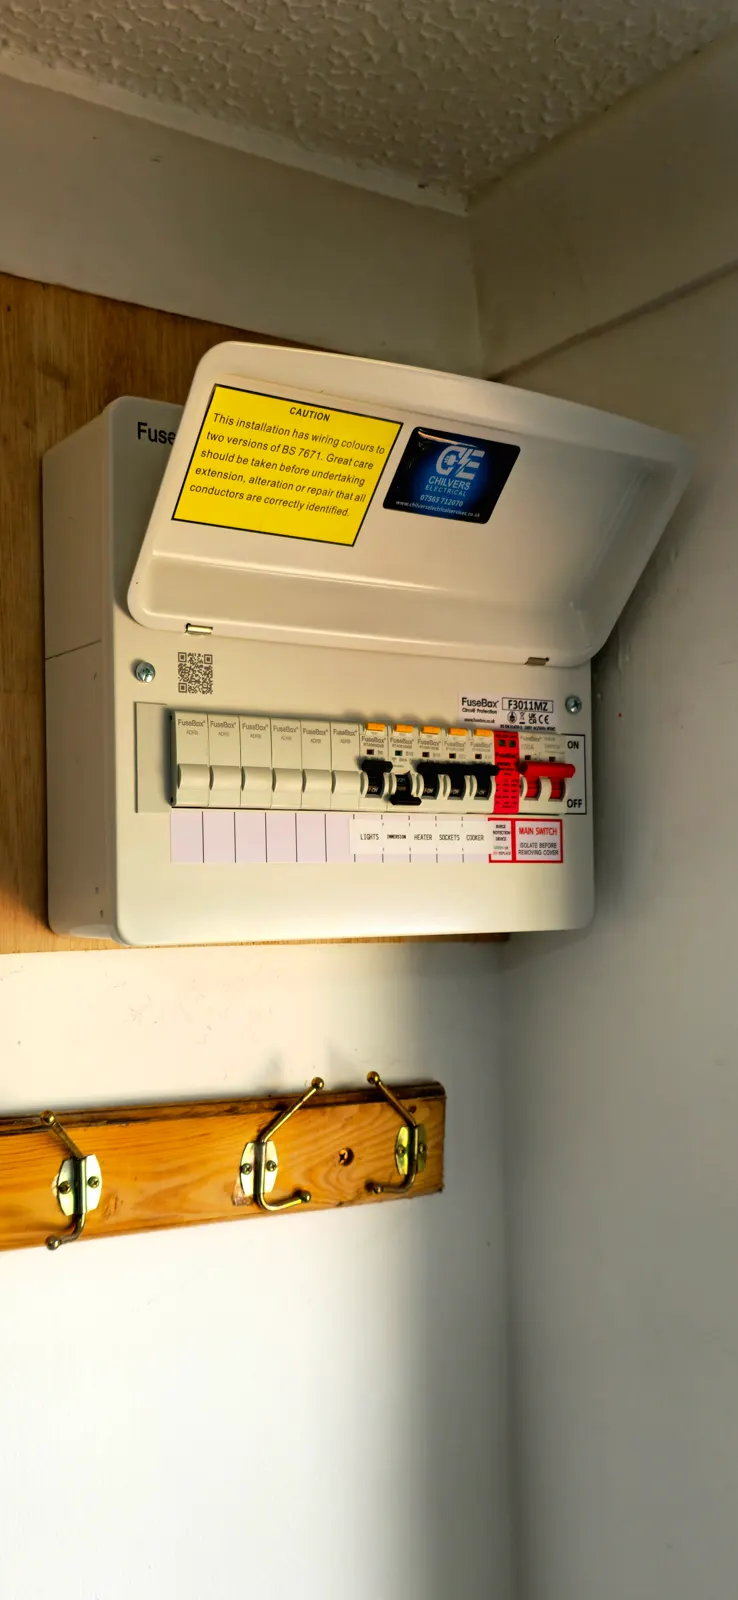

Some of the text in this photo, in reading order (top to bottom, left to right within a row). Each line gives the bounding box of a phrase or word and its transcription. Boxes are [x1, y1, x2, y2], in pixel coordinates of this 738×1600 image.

[289, 407, 330, 422] CAUTION
[213, 413, 385, 455] This installation has wiring colours to
[206, 431, 374, 470] two versions of BS 7671. Great care
[200, 449, 366, 488] should be taken before undertaking
[195, 467, 367, 503] extension, alteration or repair that all
[428, 475, 472, 491] CHILVERS
[425, 484, 467, 497] ELECTRICAL
[189, 484, 350, 517] conductors are correctly identified.
[440, 497, 464, 507] 712070
[461, 697, 499, 708] FuseBox
[507, 700, 548, 712] F3011MZ
[567, 740, 579, 750] ON
[566, 798, 583, 809] OFF
[518, 827, 558, 836] MAIN SWITCH
